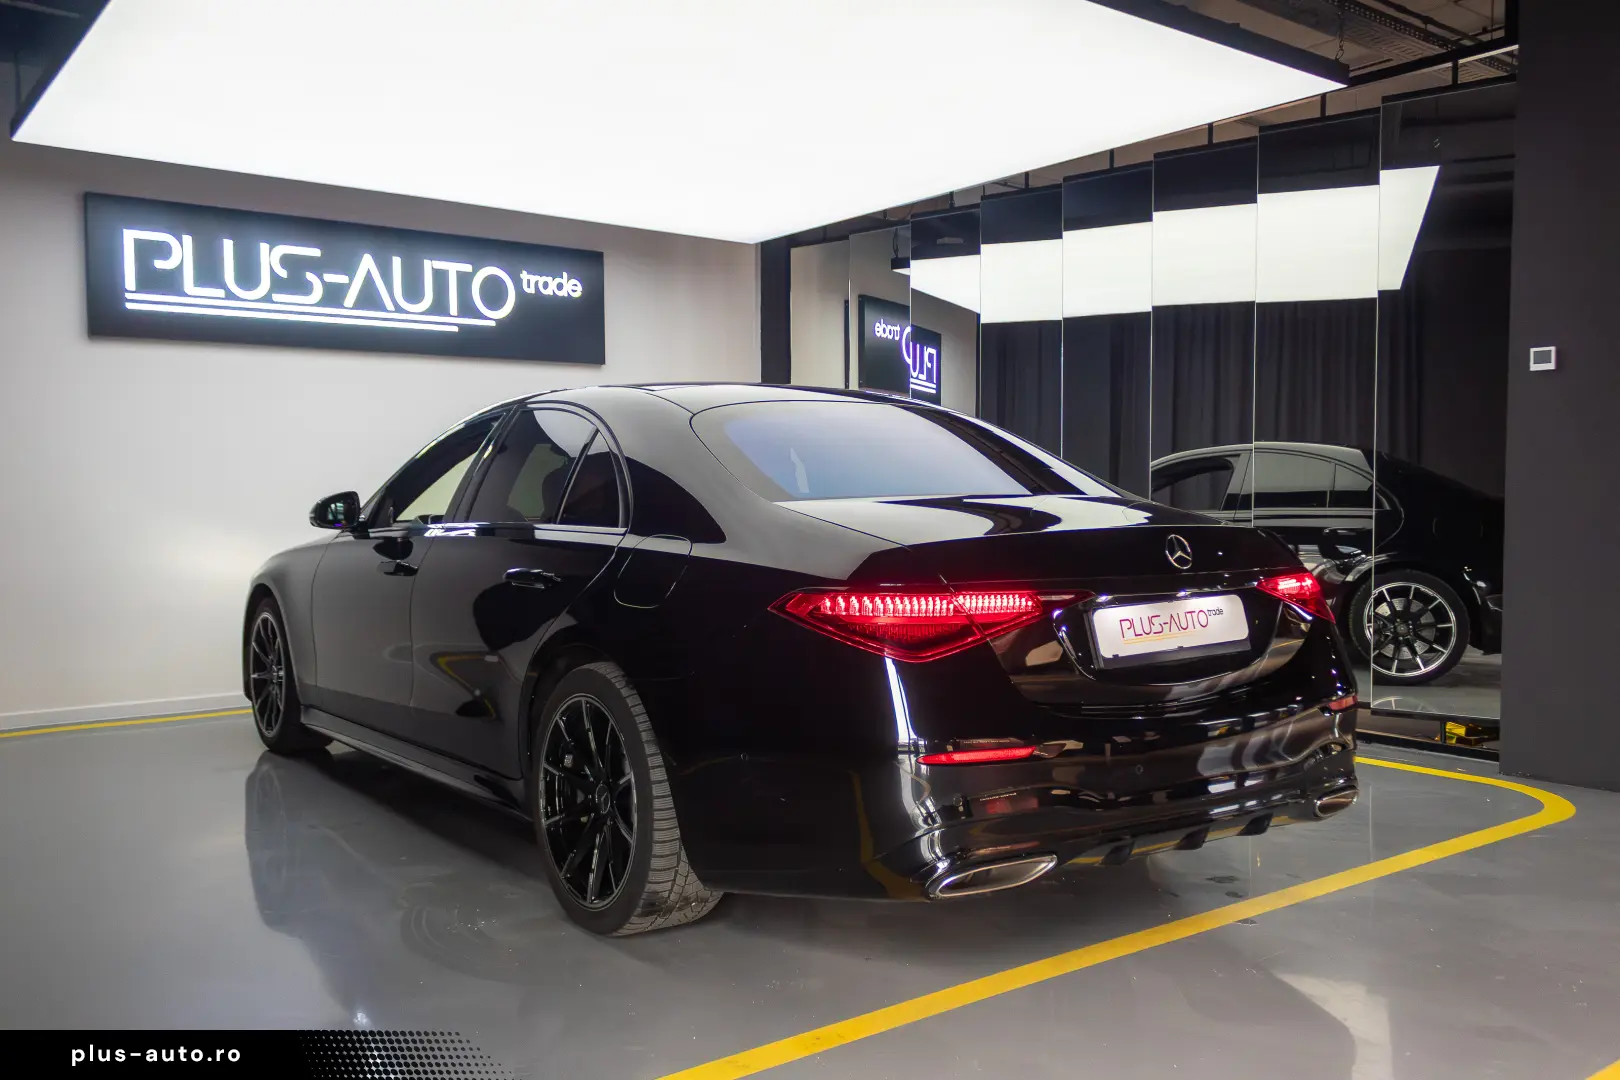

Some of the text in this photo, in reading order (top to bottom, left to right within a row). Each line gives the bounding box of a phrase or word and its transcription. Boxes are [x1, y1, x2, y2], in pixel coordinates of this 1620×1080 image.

[123, 228, 582, 319] PLUS-AUTO trade
[1119, 607, 1223, 638] PLUS-AUTO trade
